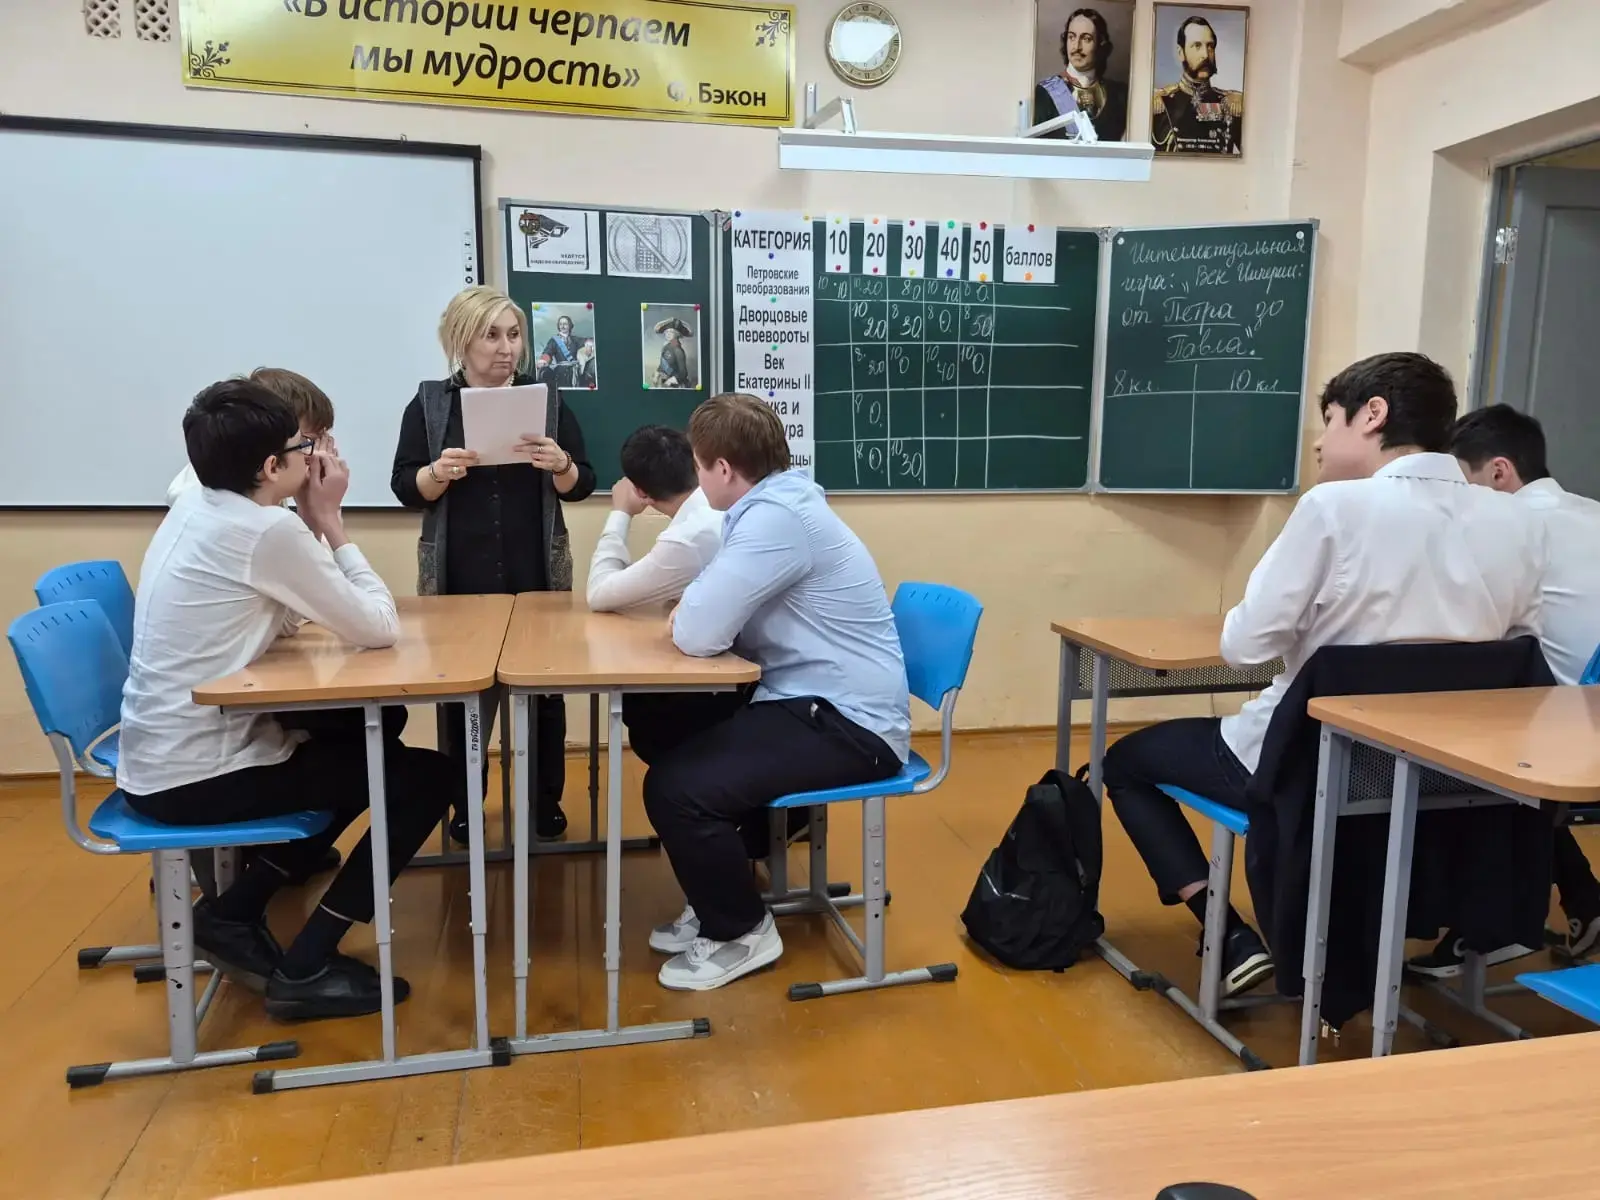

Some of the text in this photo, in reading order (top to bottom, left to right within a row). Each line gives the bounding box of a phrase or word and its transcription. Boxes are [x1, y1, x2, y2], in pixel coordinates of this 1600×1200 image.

[339, 0, 519, 36] истории
[528, 6, 691, 47] черпаем
[350, 42, 641, 91] мы мудрость»
[698, 82, 767, 107] Бэкон
[734, 229, 811, 250] КАТЕГОРИЯ
[829, 230, 848, 255] 10
[866, 232, 885, 258] 20
[904, 235, 924, 260] 30
[940, 236, 960, 262] 40
[972, 240, 991, 265] 50
[1005, 246, 1053, 267] баллов
[747, 265, 800, 282] Петровские
[736, 282, 810, 296] преобразования
[739, 305, 808, 326] Дворцовые
[852, 300, 868, 318] 10
[892, 304, 900, 319] 8
[928, 304, 935, 320] 8
[963, 305, 971, 320] 8
[1162, 297, 1237, 334] Петра
[738, 330, 810, 343] перевороты
[764, 353, 785, 370] Век
[890, 346, 902, 361] 10
[925, 345, 940, 363] 10
[960, 345, 975, 362] 10
[738, 372, 811, 390] Екатерины II
[792, 401, 800, 415] и
[856, 442, 864, 459] 8
[890, 439, 904, 457] 10
